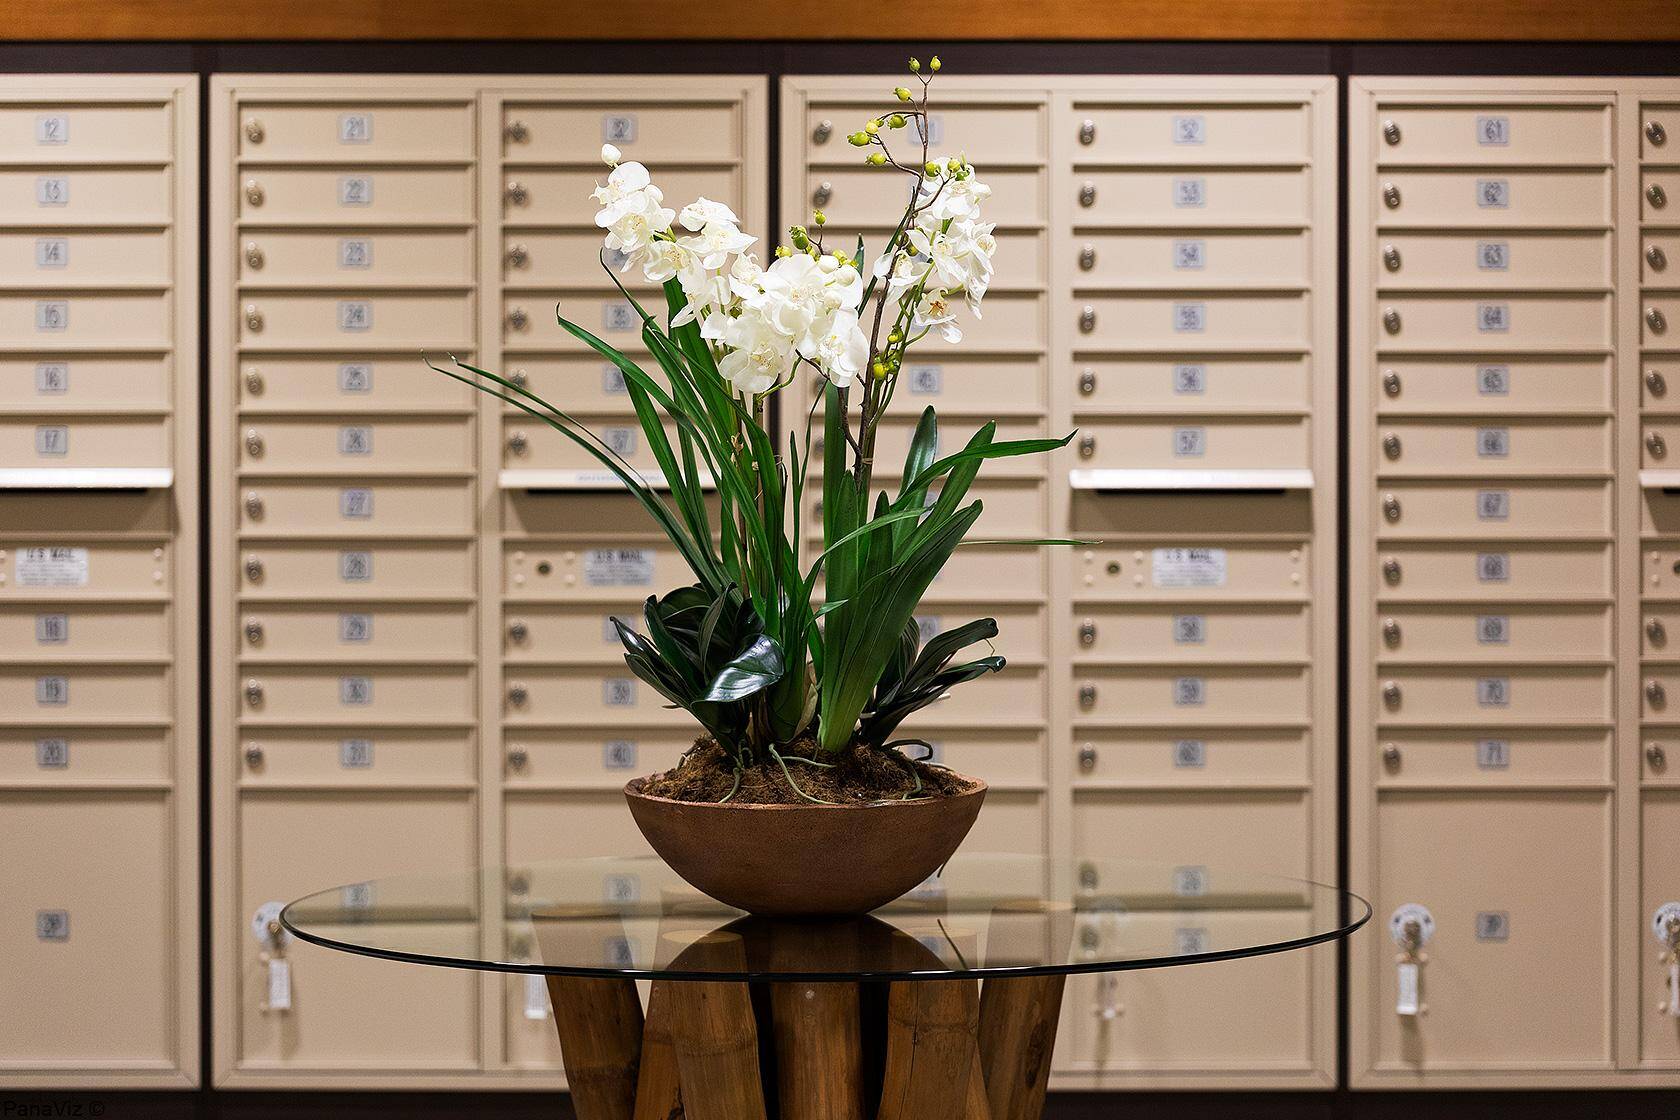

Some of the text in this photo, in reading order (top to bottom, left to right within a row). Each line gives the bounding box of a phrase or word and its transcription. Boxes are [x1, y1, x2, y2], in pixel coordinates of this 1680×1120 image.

[45, 119, 60, 137] 12
[346, 117, 364, 136] 21
[1485, 120, 1502, 140] 61
[45, 242, 60, 261] 14
[45, 305, 60, 325] 15
[45, 430, 59, 450] 17
